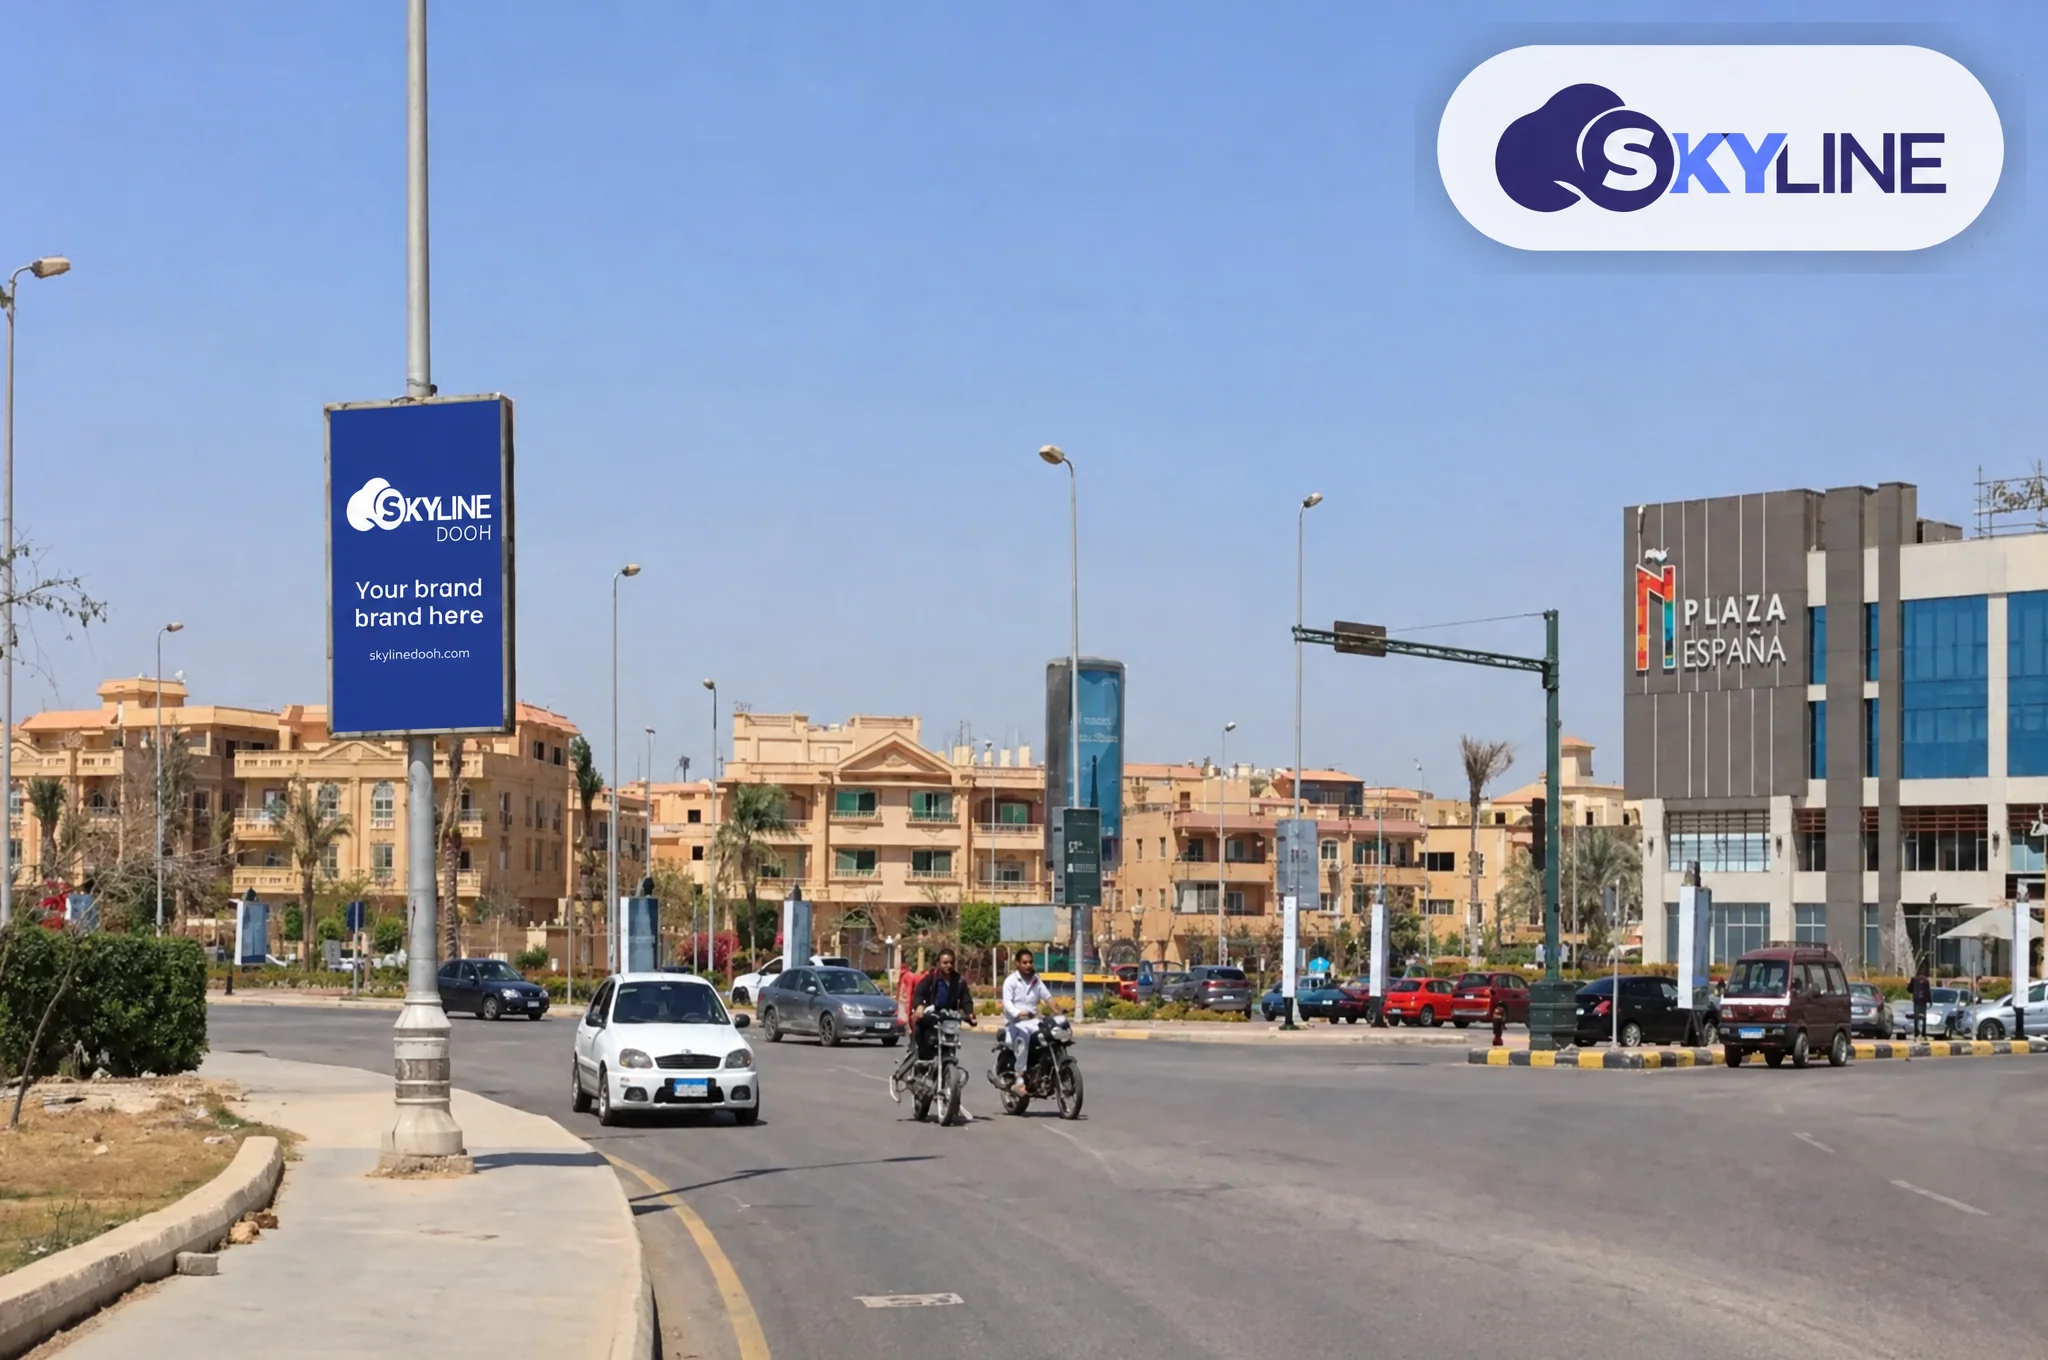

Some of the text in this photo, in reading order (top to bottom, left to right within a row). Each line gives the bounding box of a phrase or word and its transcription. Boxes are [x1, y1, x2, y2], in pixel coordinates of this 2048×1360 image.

[382, 494, 492, 523] SKYLINE
[436, 524, 492, 542] DOOH
[355, 577, 482, 600] Your brand
[355, 605, 484, 628] brand here
[1684, 593, 1787, 626] PLAZA
[369, 648, 470, 663] skylinedooh.com
[1683, 628, 1787, 668] ESPAÑA
